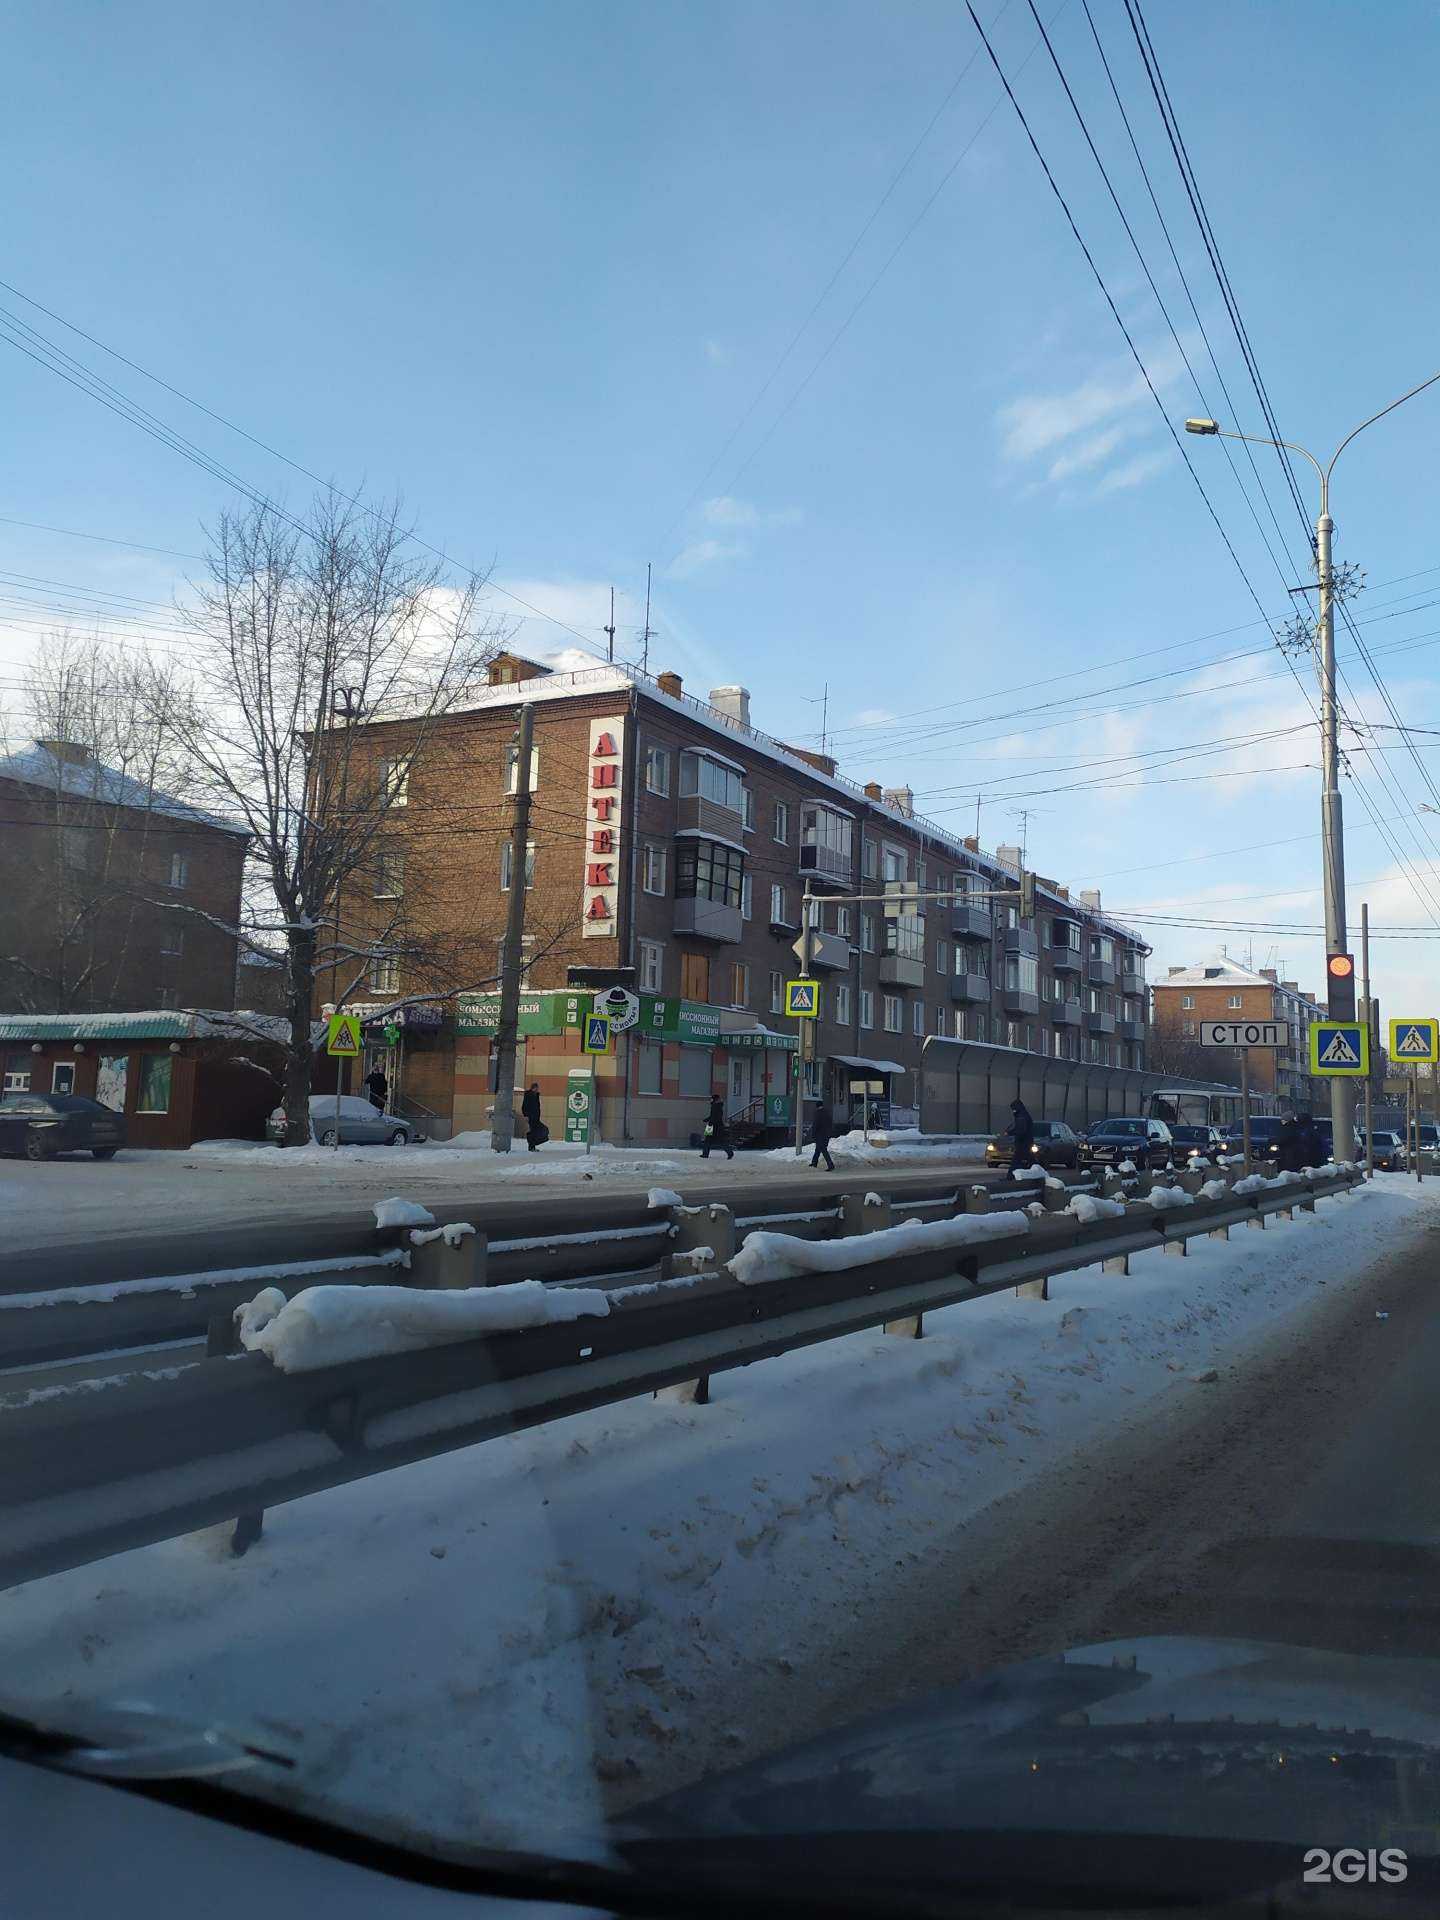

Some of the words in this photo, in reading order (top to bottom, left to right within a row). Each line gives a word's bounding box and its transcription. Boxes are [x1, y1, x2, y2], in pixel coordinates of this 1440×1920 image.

[586, 732, 618, 920] АПТЕКА
[459, 1002, 540, 1014] КОМИССИНЫЙ
[1212, 1025, 1278, 1043] СТОП
